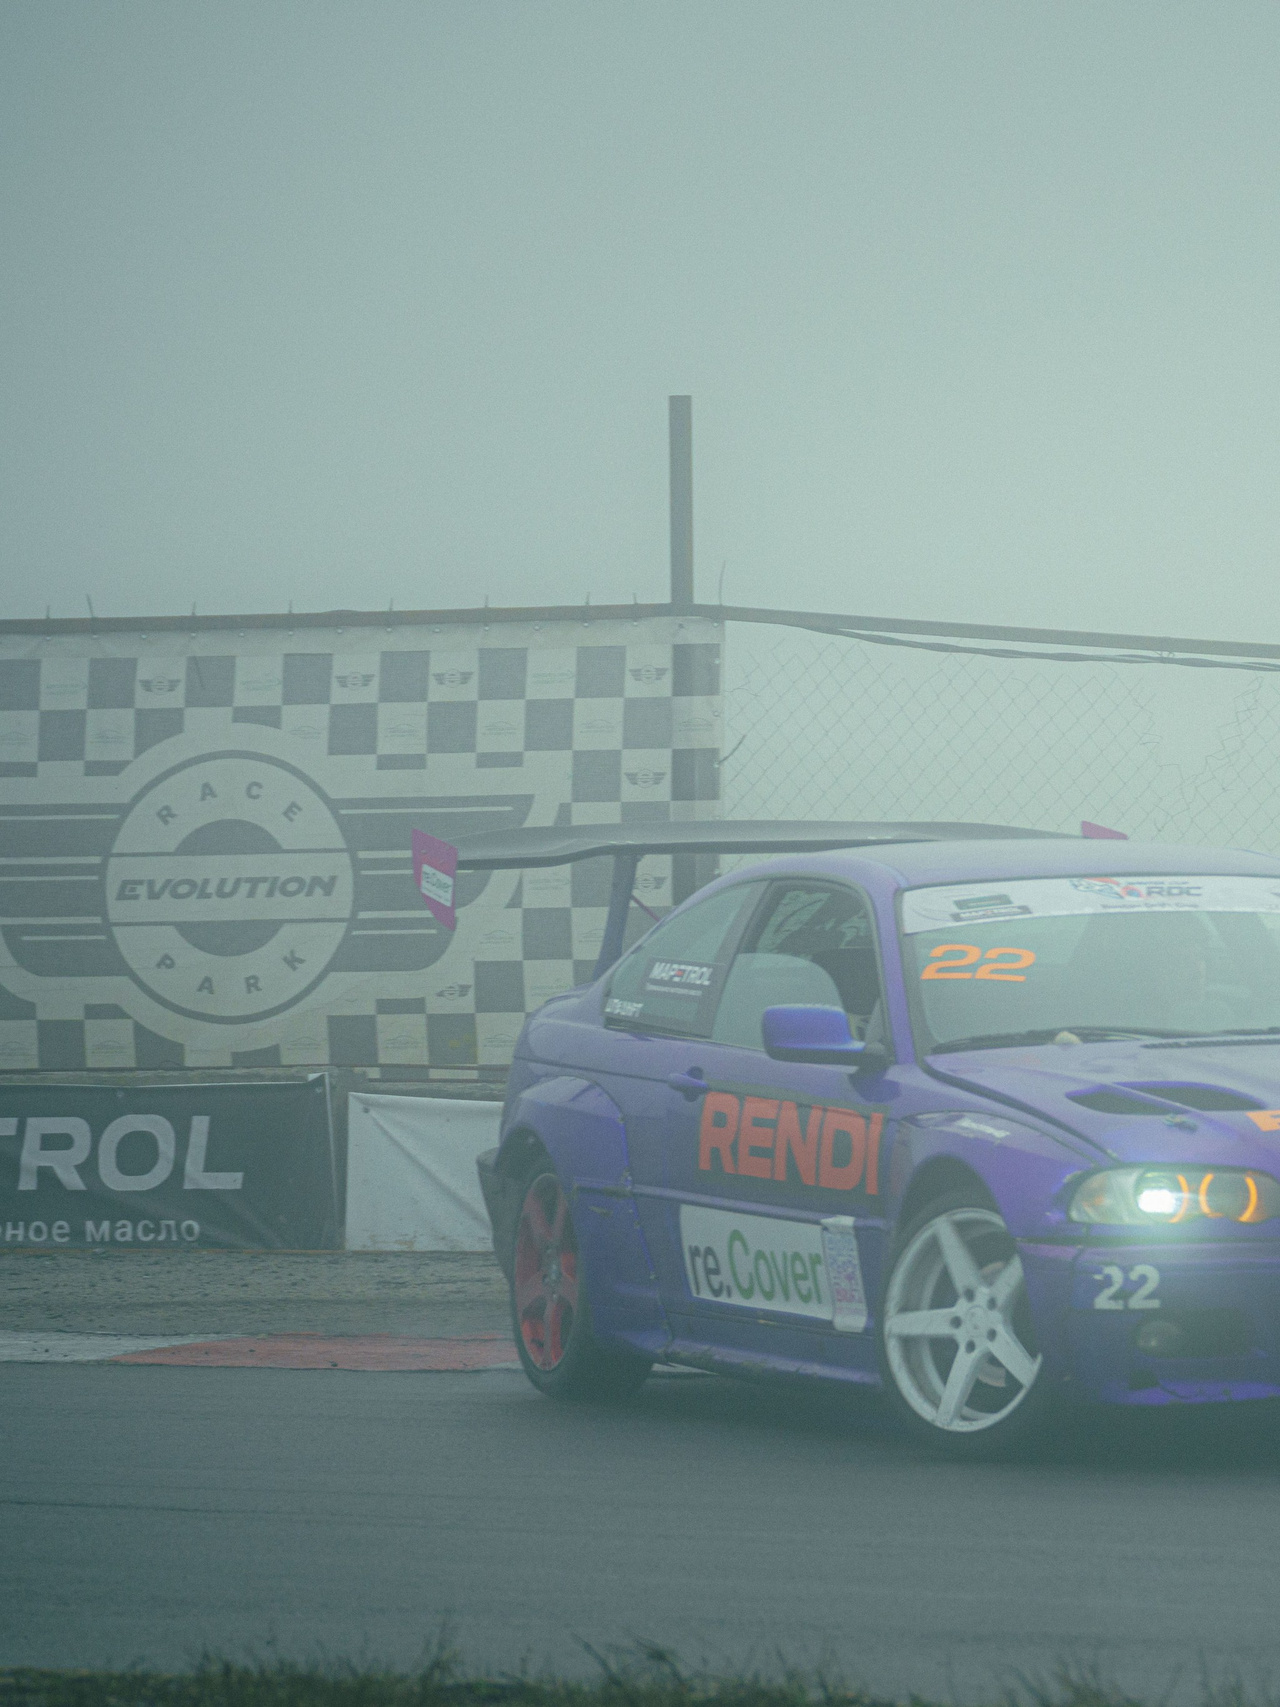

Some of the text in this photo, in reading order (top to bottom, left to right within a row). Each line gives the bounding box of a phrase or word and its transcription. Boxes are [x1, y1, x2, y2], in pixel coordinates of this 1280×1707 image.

[156, 781, 302, 825] RACE
[115, 875, 338, 901] EVOLUTION
[156, 949, 306, 995] PARK
[648, 961, 714, 986] MAPETROL
[920, 943, 1037, 983] 22
[699, 1090, 885, 1196] RENDI
[0, 1219, 201, 1243] ное масло
[688, 1229, 824, 1305] re.Cover
[1092, 1263, 1161, 1310] 22
